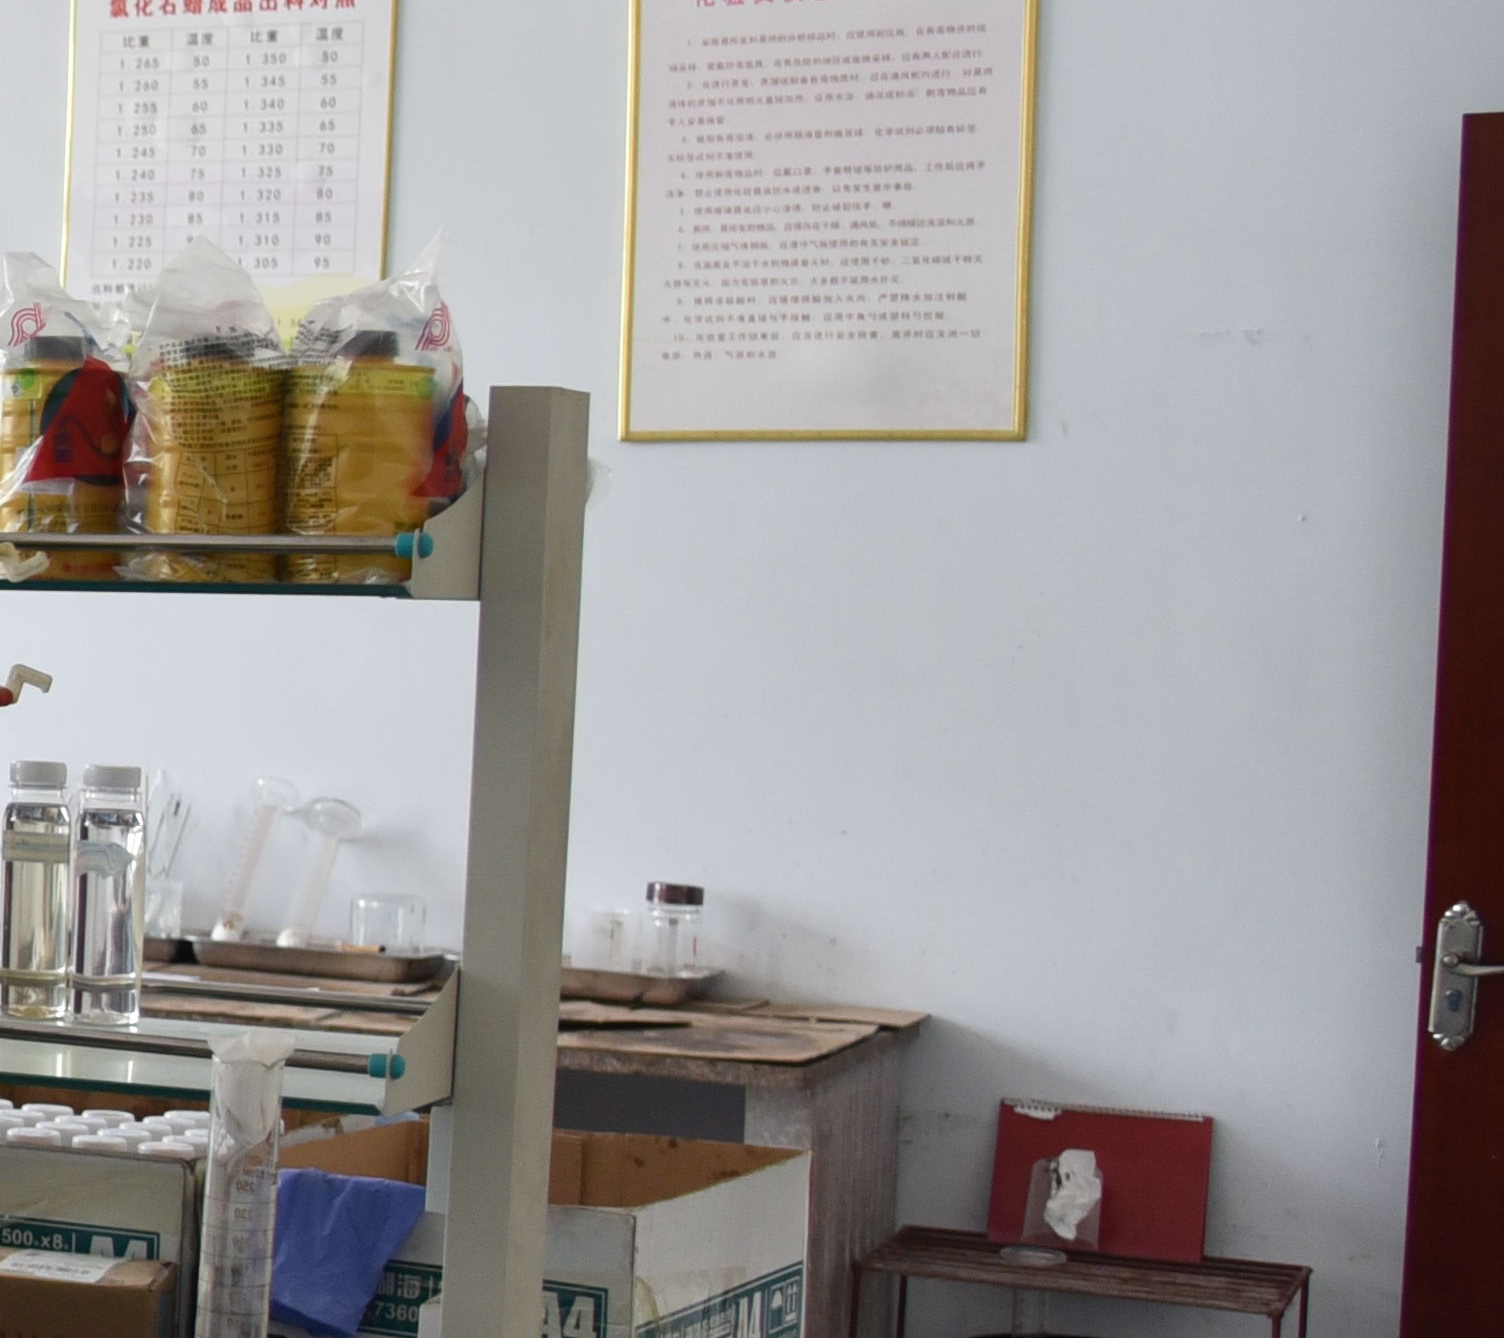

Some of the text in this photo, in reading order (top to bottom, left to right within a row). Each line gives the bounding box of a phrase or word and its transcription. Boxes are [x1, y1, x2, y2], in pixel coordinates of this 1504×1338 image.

[193, 55, 209, 68] 50
[321, 50, 338, 63] 50
[193, 77, 209, 90] 55
[320, 73, 337, 86] 55
[192, 100, 208, 113] 60
[320, 96, 336, 109] 60
[190, 122, 207, 136] 65
[319, 118, 335, 132] 65
[190, 144, 206, 157] 70
[319, 141, 335, 155] 70
[190, 166, 205, 180] 75
[318, 164, 333, 178] 75
[188, 189, 204, 202] 80
[316, 187, 333, 200] 80
[187, 212, 203, 225] 85
[315, 210, 332, 223] 85
[314, 233, 331, 246] 90
[313, 256, 330, 269] 95
